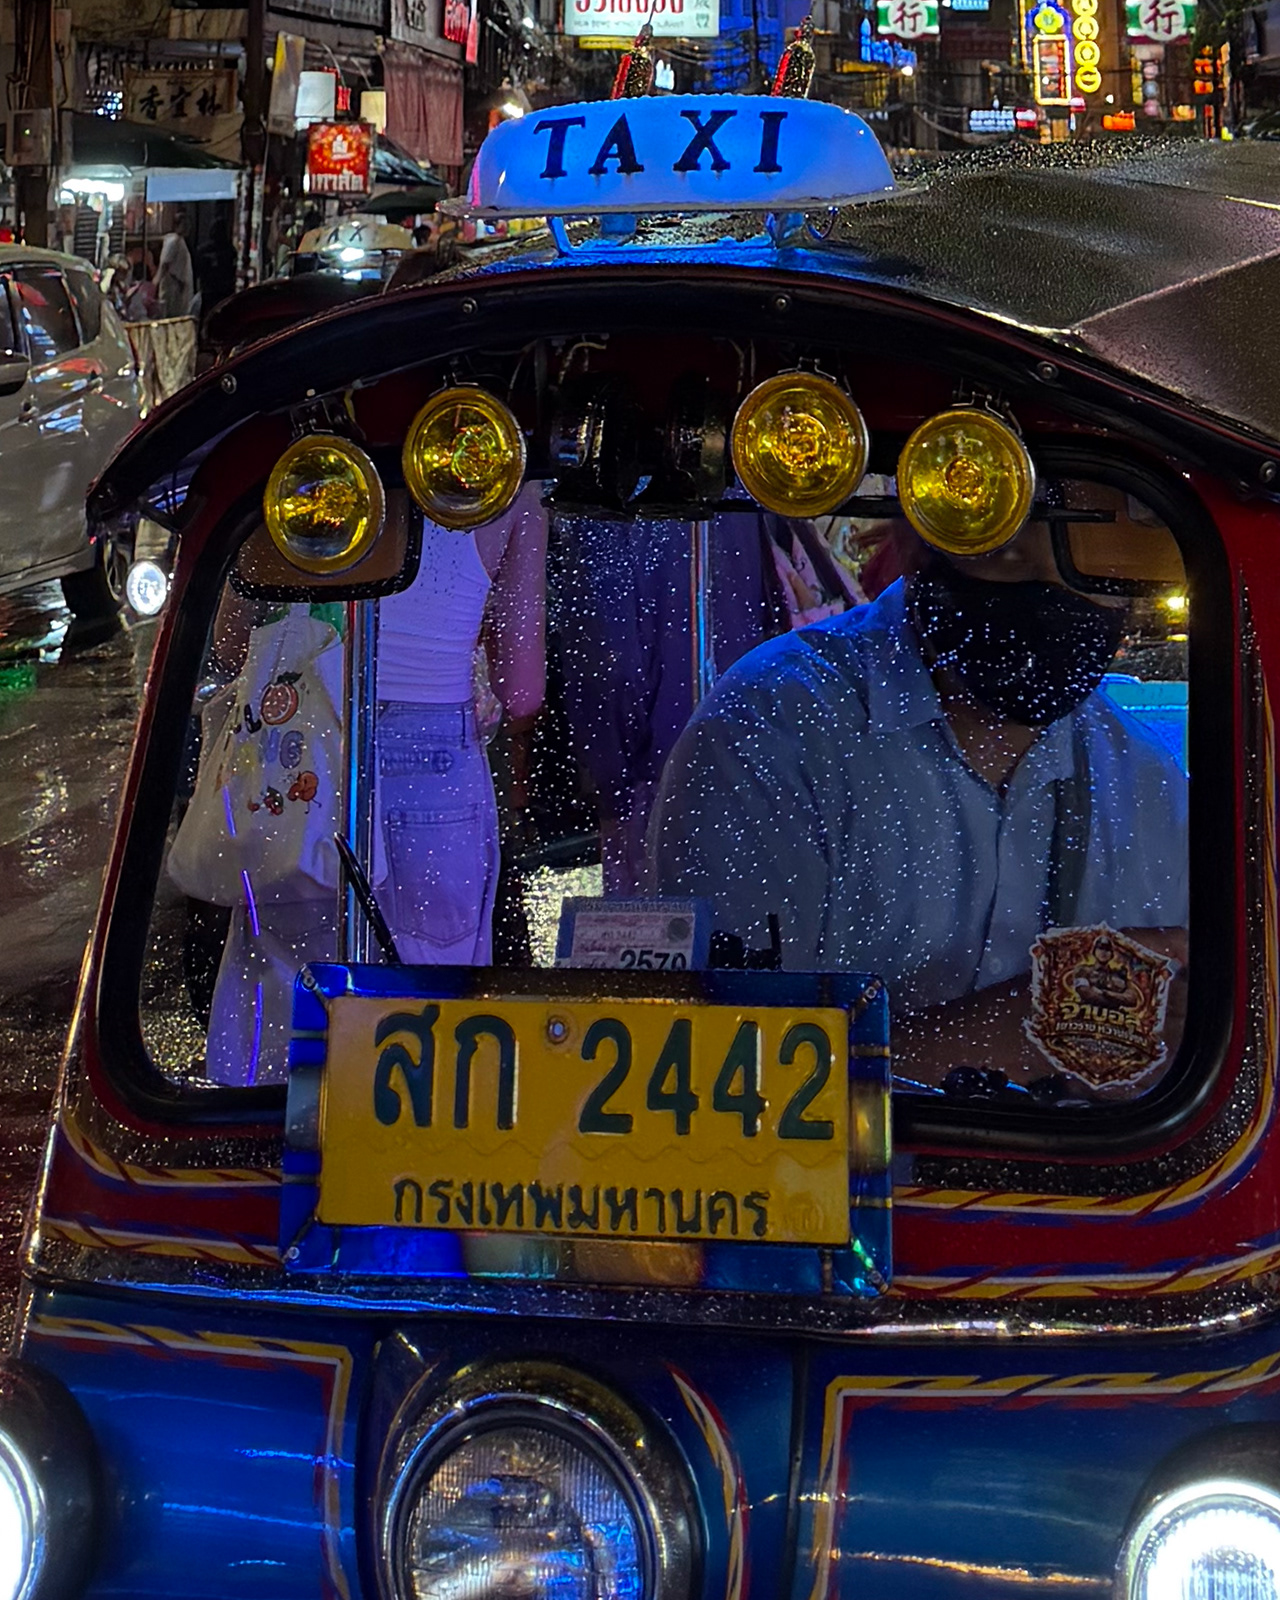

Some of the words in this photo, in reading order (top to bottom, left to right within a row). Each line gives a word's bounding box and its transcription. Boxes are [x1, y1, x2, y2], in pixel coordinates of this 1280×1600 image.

[533, 109, 789, 180] TAXI
[373, 1004, 518, 1131] สก
[577, 1016, 834, 1141] 2442
